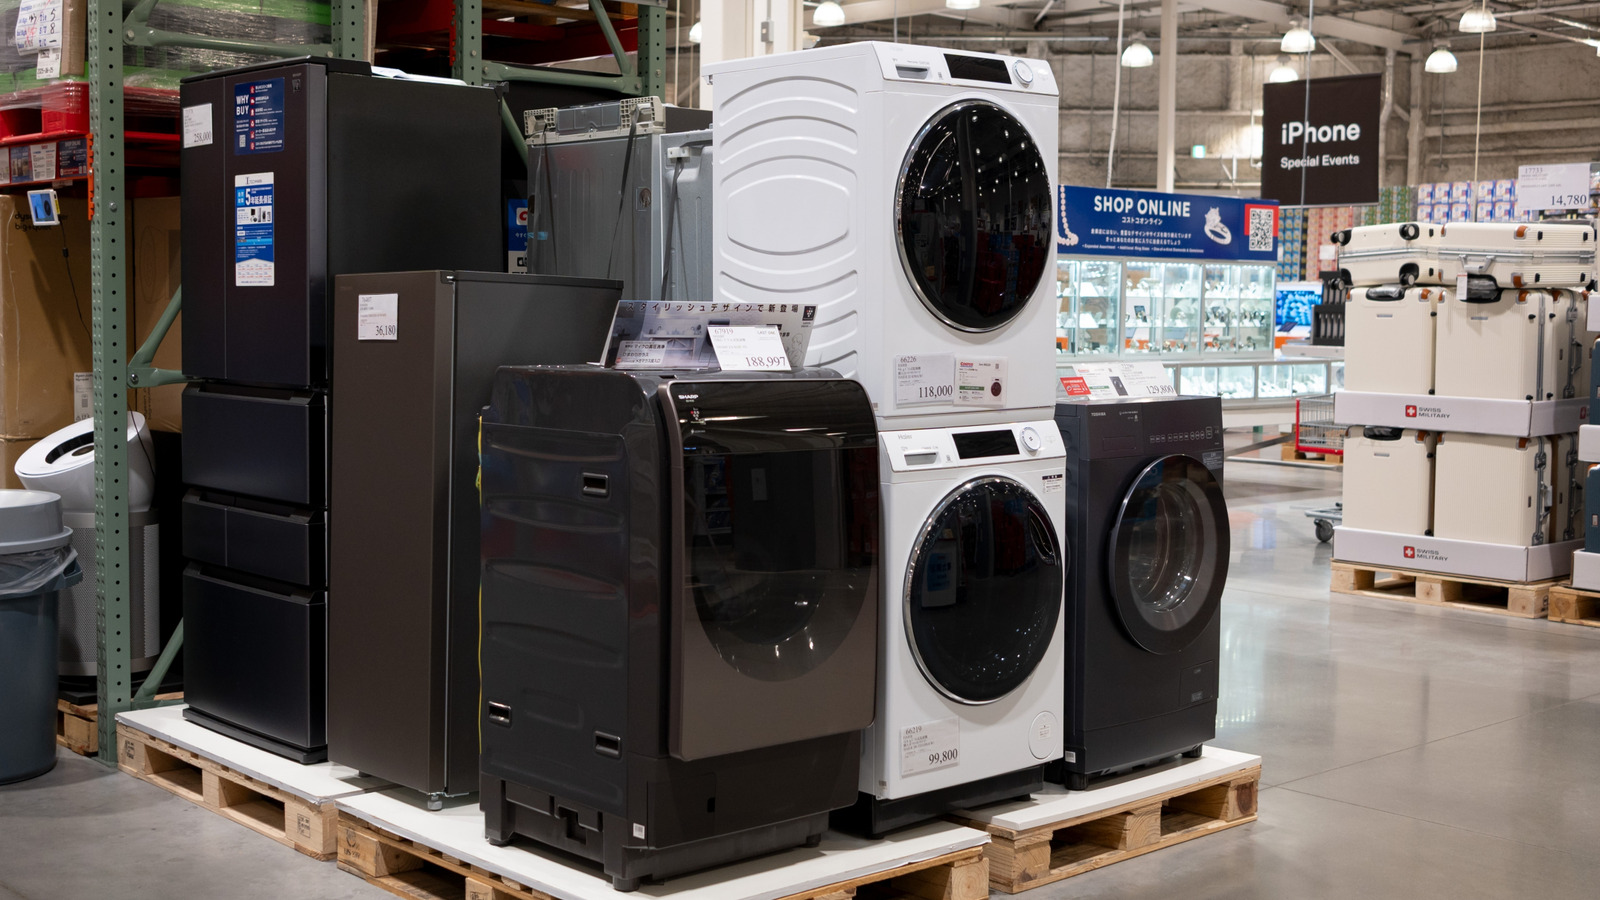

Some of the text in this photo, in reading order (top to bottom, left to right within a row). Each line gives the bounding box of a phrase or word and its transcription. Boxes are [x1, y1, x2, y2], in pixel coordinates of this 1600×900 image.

[50, 22, 56, 34] 8
[236, 94, 249, 105] WHY
[236, 105, 249, 116] BUY
[194, 131, 212, 142] 258,000
[1282, 121, 1360, 145] iPhone
[1280, 154, 1360, 170] Special Events
[1552, 194, 1587, 206] 14,780
[1094, 196, 1191, 217] SHOP ONLINE
[1122, 216, 1163, 226] コストコオンライン
[626, 302, 799, 313] スタイリッシュデザインで新登場
[376, 324, 396, 337] 36,180
[746, 356, 786, 368] 188,997
[920, 385, 953, 398] 118,000
[1146, 384, 1174, 394] 129,800
[905, 726, 922, 735] 66219
[928, 748, 958, 766] 99,800
